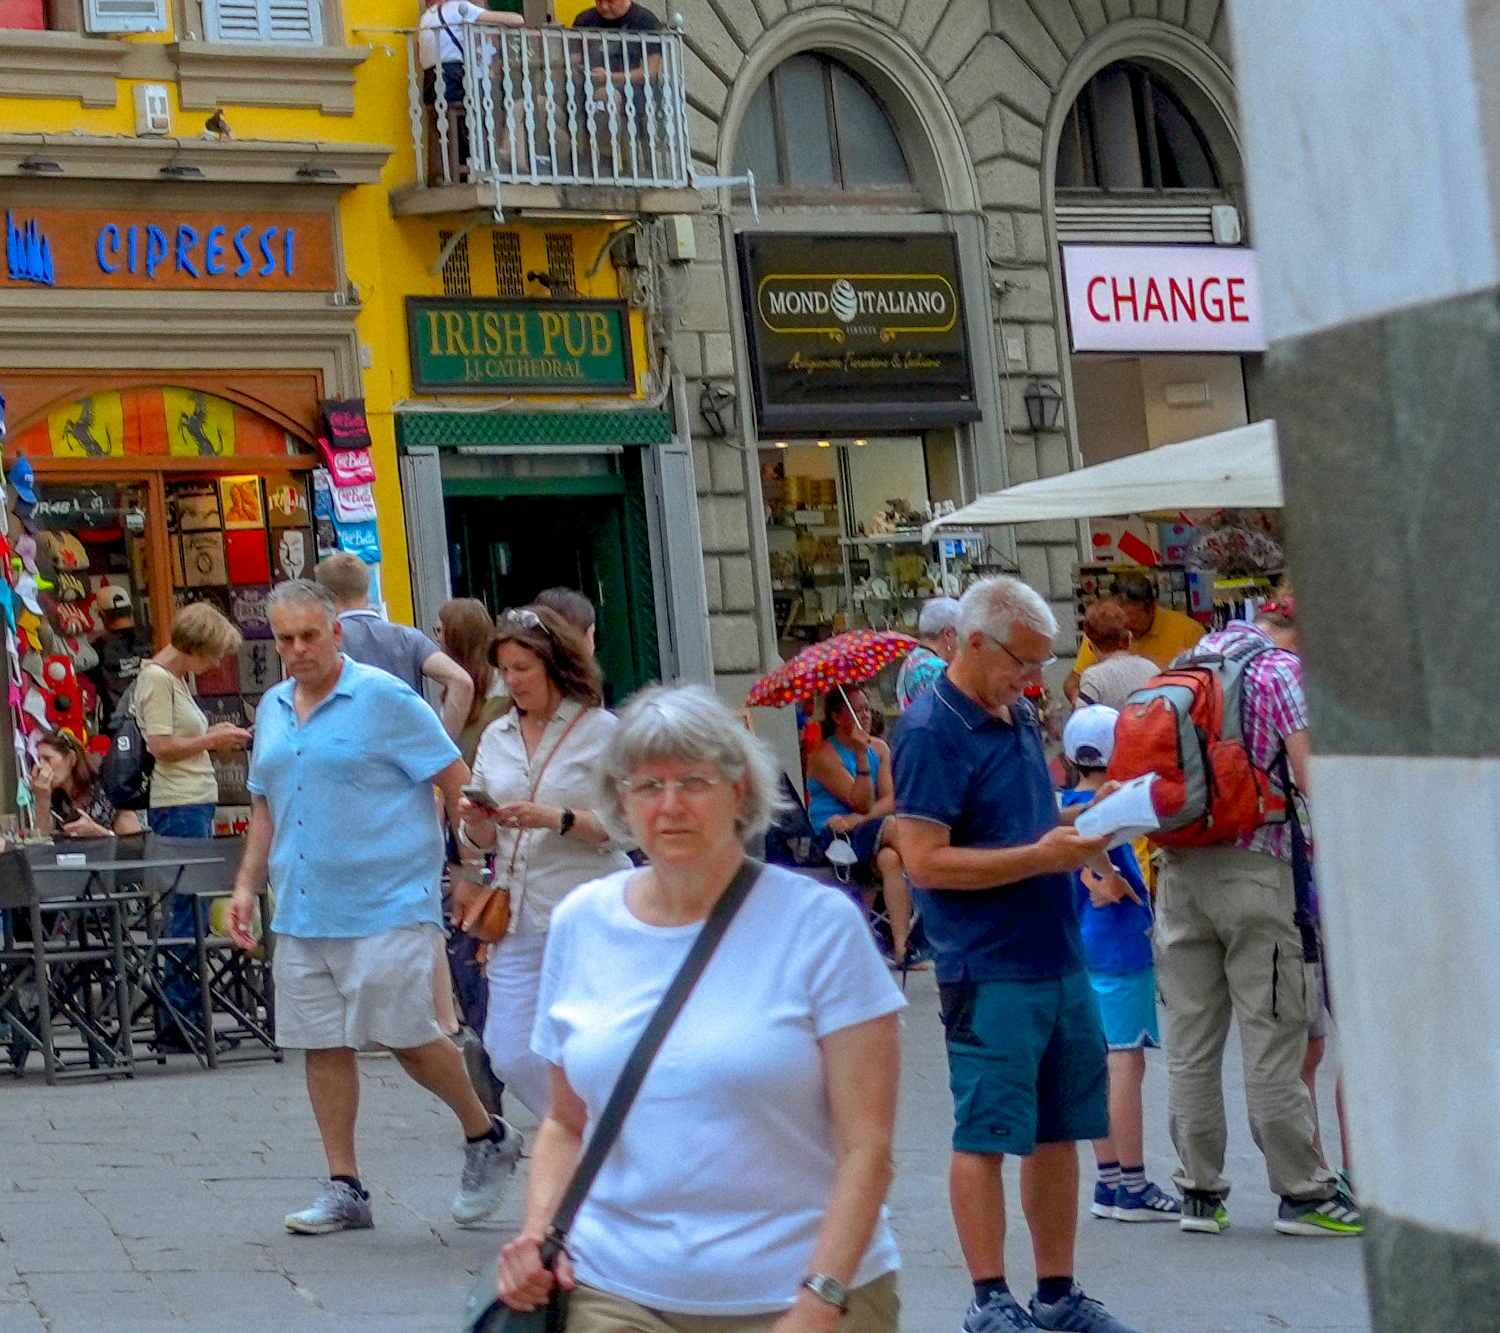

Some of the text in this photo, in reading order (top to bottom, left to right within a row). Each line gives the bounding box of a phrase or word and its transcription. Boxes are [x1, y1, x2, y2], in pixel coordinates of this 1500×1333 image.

[96, 223, 294, 277] CIPRESSI
[857, 289, 947, 315] ITALIANO
[1086, 276, 1250, 323] CHANGE
[426, 310, 613, 357] IRISH PUB
[485, 358, 585, 379] CATHEDRAL
